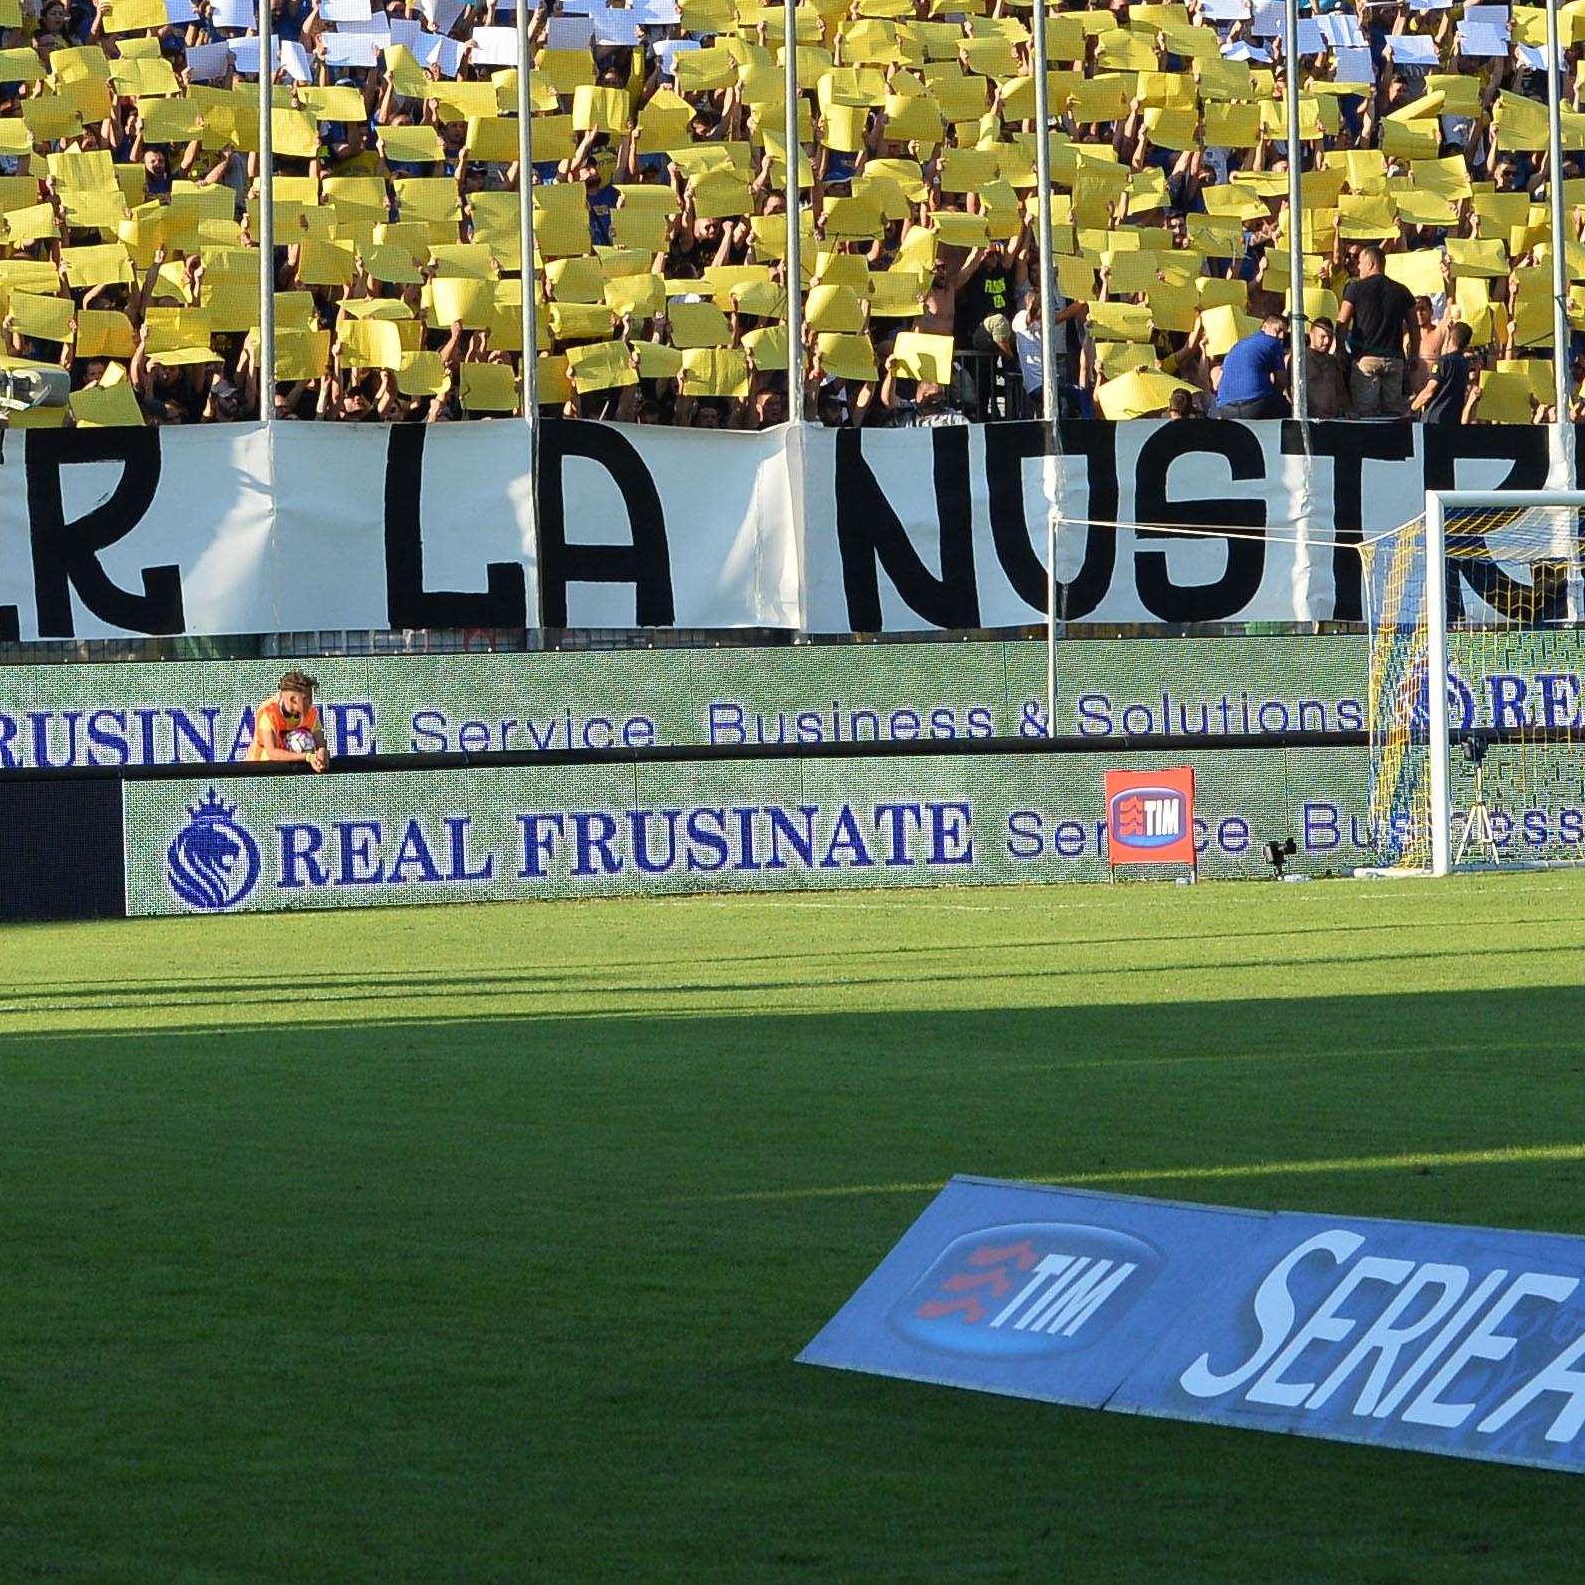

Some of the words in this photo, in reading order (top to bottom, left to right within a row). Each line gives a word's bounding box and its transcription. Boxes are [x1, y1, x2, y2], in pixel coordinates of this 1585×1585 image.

[385, 418, 675, 629] LA
[709, 701, 994, 744] Business
[1019, 701, 1050, 738] &
[1078, 691, 1363, 736] Solutions
[275, 816, 495, 888] REAL
[517, 801, 974, 878] FRUSINATE
[1144, 798, 1179, 835] TIM
[989, 1253, 1138, 1337] TIM
[1179, 1229, 1581, 1428] SERIE
